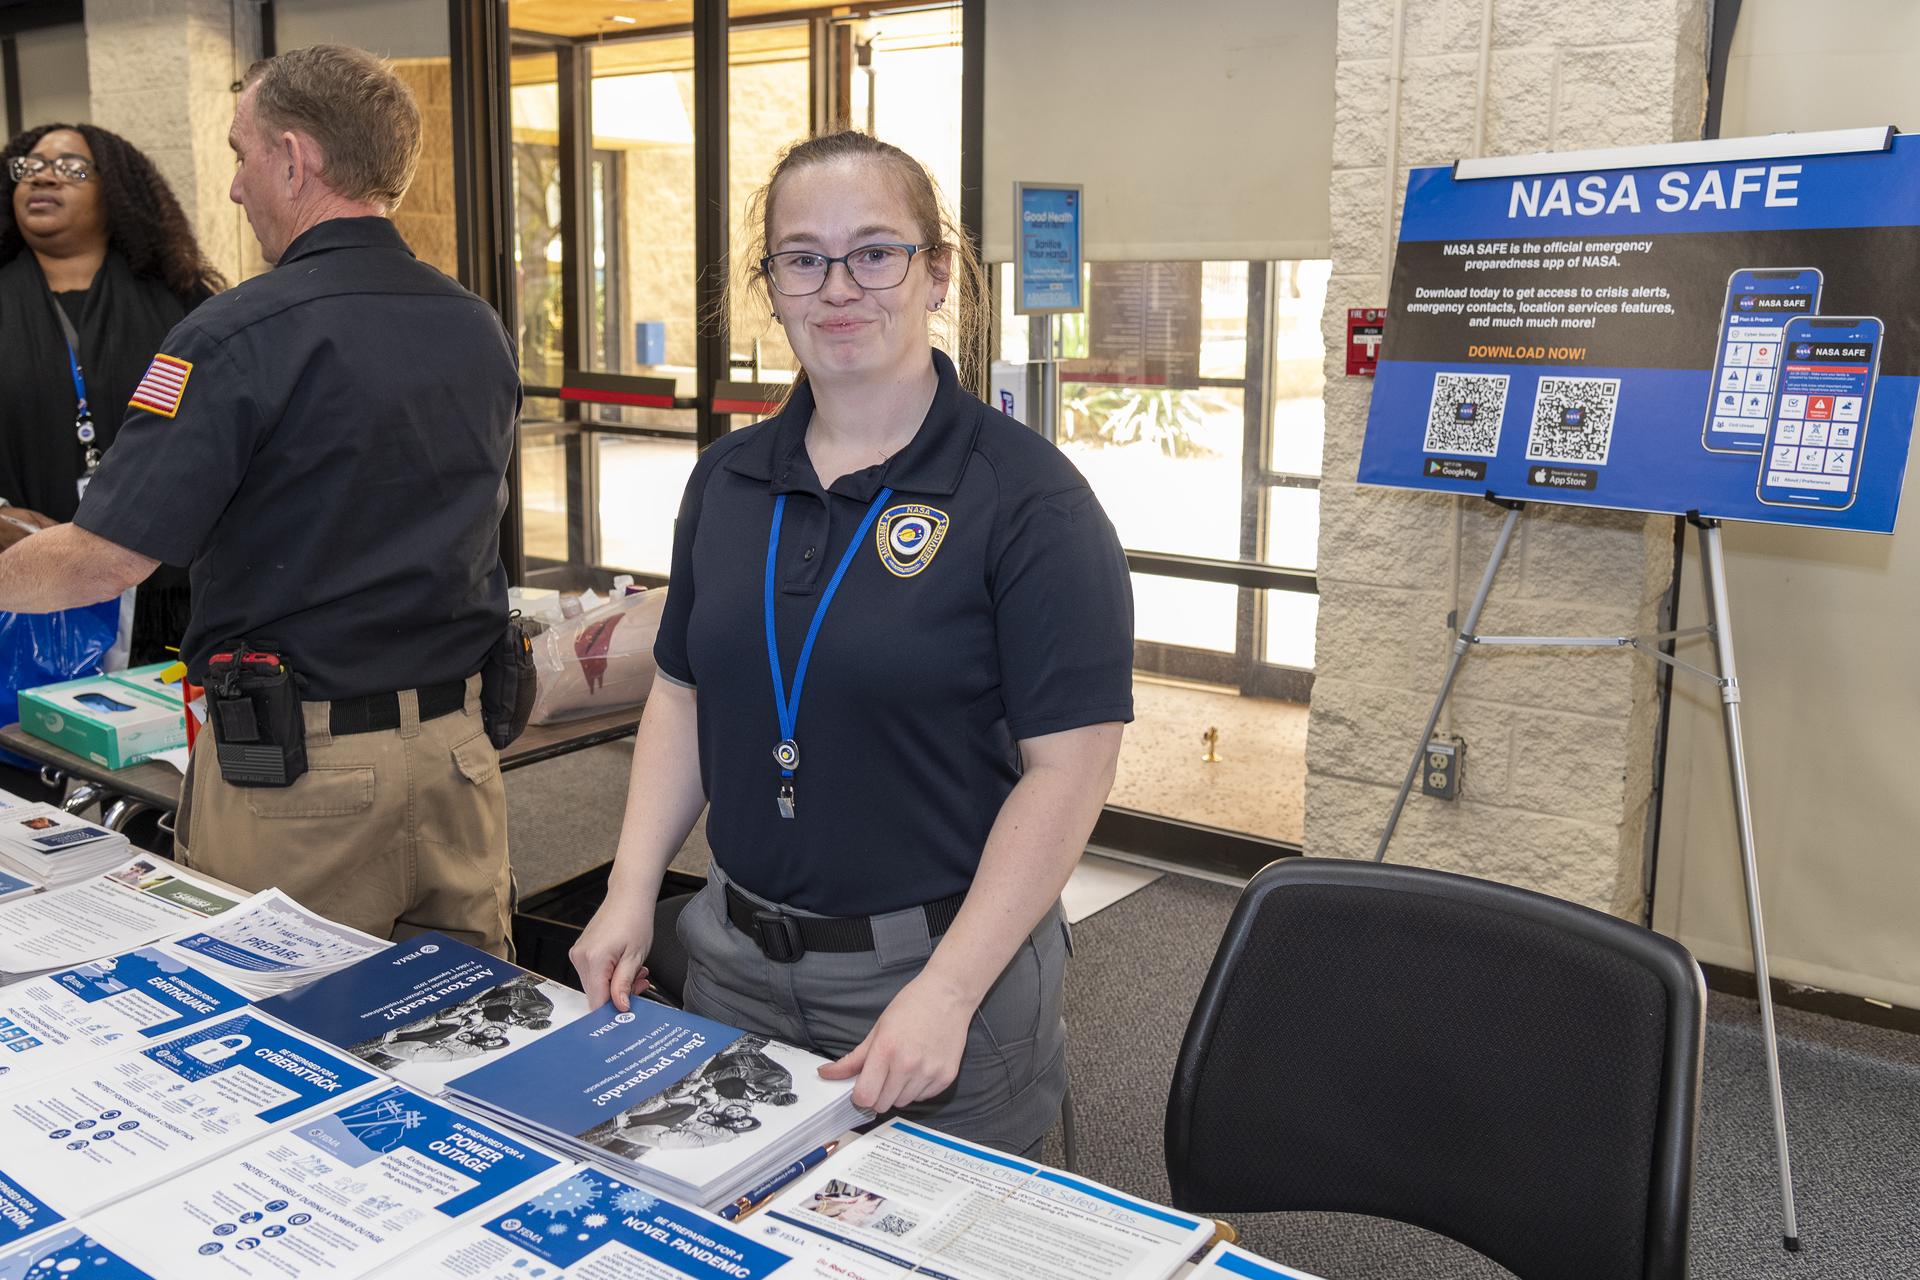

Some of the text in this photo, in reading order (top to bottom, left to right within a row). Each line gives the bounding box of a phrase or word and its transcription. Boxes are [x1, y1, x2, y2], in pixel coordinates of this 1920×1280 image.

[1509, 164, 1802, 218] NASA SAFE
[1024, 211, 1073, 222] Good Health
[1444, 241, 1652, 256] NASA SAFE is the official emergency
[1465, 256, 1621, 271] preparedness app of NASA.
[1415, 287, 1670, 300] Download today to get access to crisis alerts,
[1407, 302, 1675, 315] emergency contacts, location services features,
[1469, 317, 1595, 328] and much much more!
[1468, 346, 1586, 360] DOWNLOAD NOW!
[1816, 348, 1840, 356] NASA
[1442, 468, 1478, 479] Google Play
[1550, 475, 1586, 486] App Store
[906, 506, 931, 515] NASA
[920, 525, 946, 564] SERVICES
[277, 930, 324, 948] TAKE ACTION
[242, 936, 304, 961] PREPARE
[393, 951, 422, 966] FEMA
[432, 979, 450, 989] Guide
[147, 976, 216, 1015] EARTHQUAKE
[383, 968, 494, 1020] Are You Ready?
[360, 998, 404, 1019] Preparedness
[589, 1021, 619, 1037] FEMA
[254, 1048, 343, 1092] CYBERATTACK
[288, 1052, 320, 1071] PREPARED
[319, 1067, 334, 1077] FOR
[592, 1033, 706, 1107] ¿Está preparado?
[446, 1133, 504, 1163] POWER
[452, 1123, 466, 1131] BE
[463, 1127, 503, 1148] PREPARED
[501, 1145, 519, 1156] FOR
[429, 1141, 491, 1173] OUTAGE
[892, 1133, 937, 1155] Electric
[944, 1152, 990, 1172] Vehicle
[1056, 1189, 1104, 1213] Safety
[1104, 1206, 1138, 1225] Tips
[240, 1162, 271, 1180] PROTECT
[270, 1178, 303, 1199] YOURSELF
[302, 1196, 327, 1212] DURING
[330, 1212, 357, 1228] POWER
[355, 1225, 384, 1244] OUTAGE
[516, 1226, 544, 1244] FEMA
[654, 1216, 744, 1261] BE PREPARED FOR A
[779, 1231, 805, 1247] FEMA
[622, 1216, 750, 1278] NOVEL PANDEMIC
